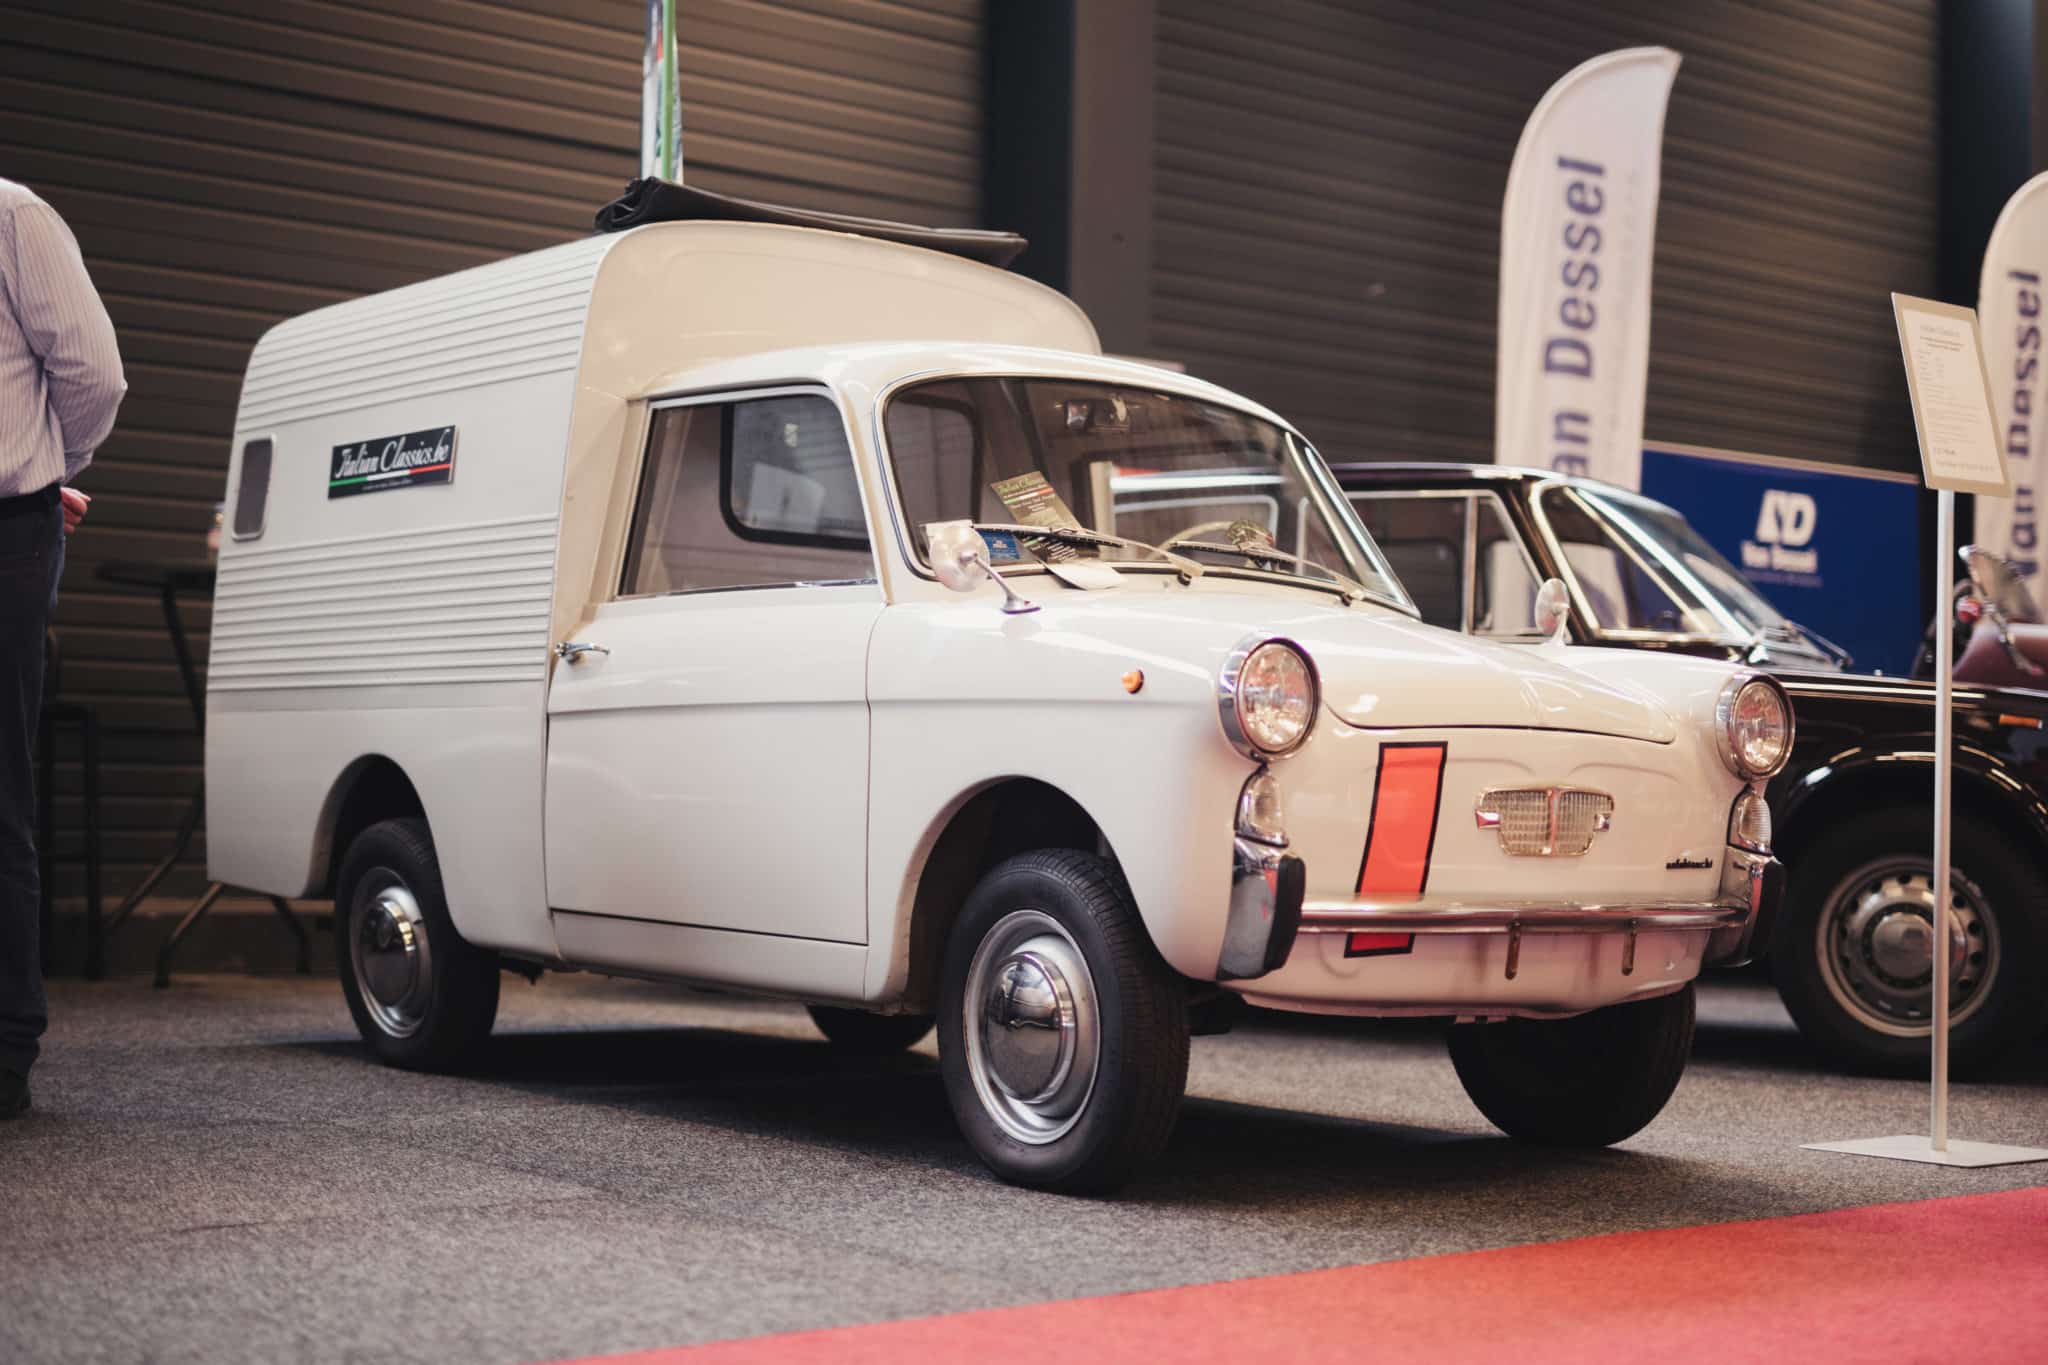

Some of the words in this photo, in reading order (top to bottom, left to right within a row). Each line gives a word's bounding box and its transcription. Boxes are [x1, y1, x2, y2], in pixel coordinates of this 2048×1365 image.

[1544, 156, 1606, 379] Dessel
[1551, 411, 1590, 478] an
[2006, 269, 2041, 457] Dessel
